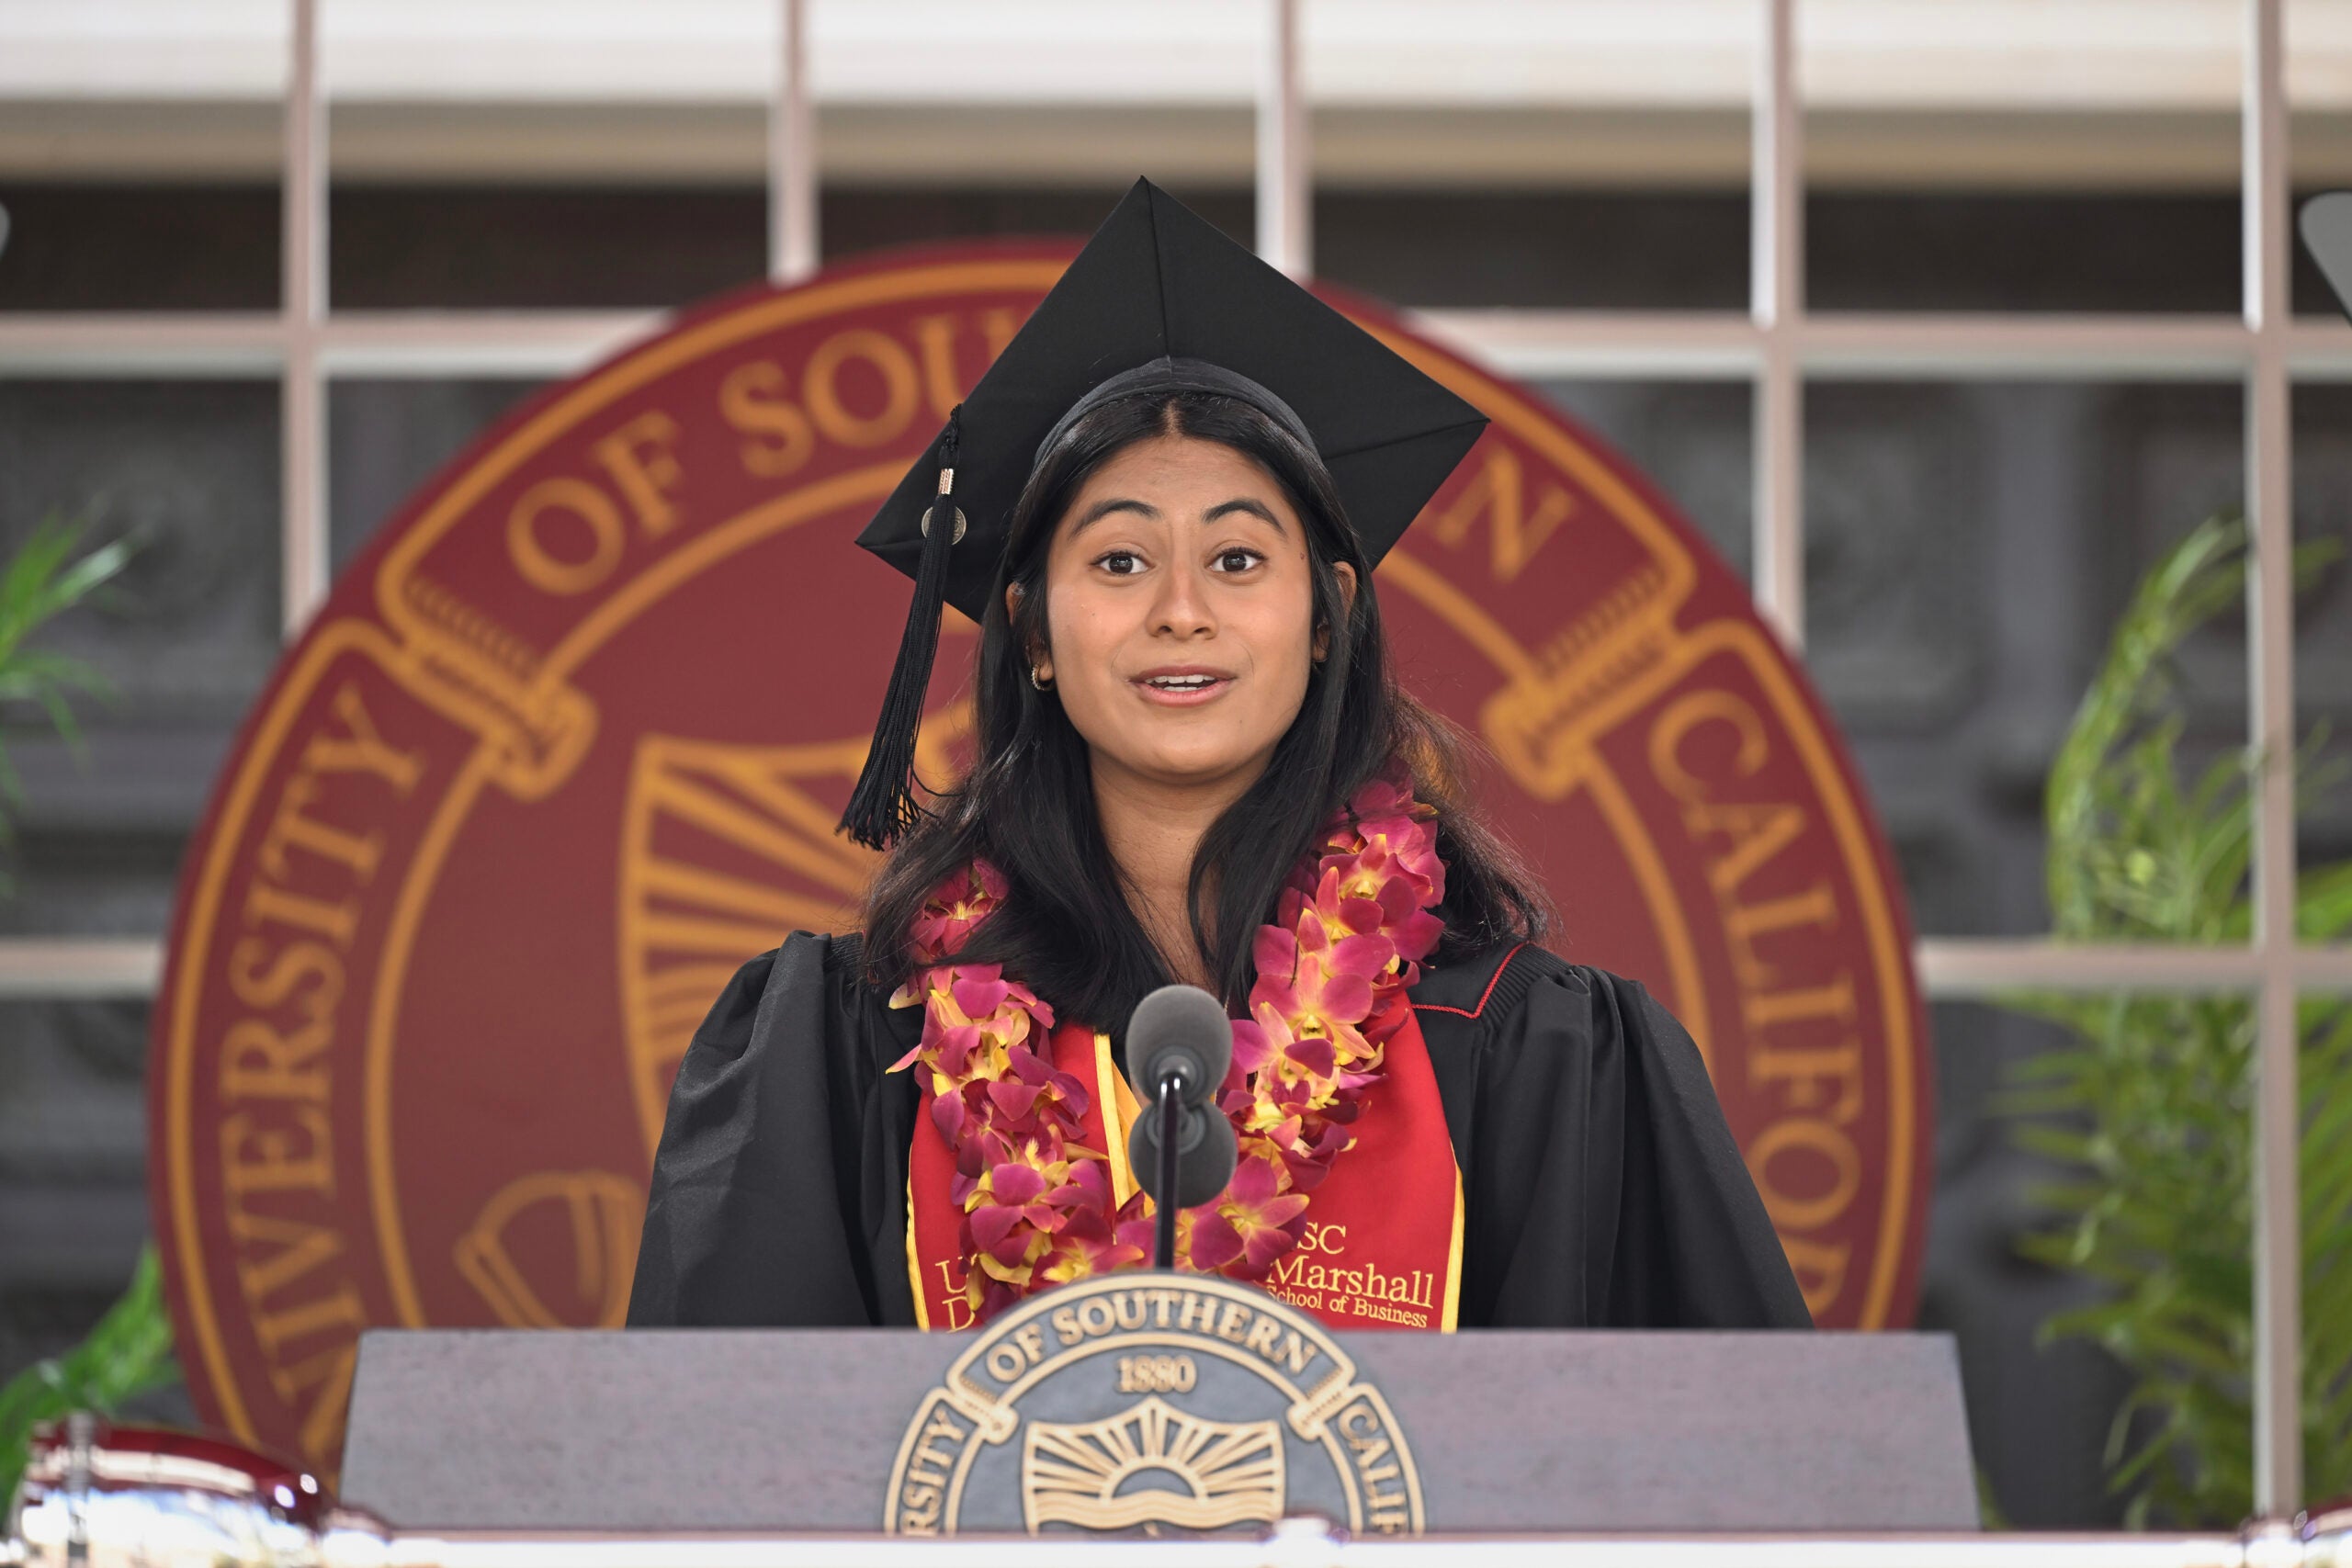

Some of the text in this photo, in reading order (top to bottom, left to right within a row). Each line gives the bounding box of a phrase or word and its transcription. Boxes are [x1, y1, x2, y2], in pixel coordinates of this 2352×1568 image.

[506, 407, 684, 596] OF
[219, 680, 426, 1497] NIVERSITY
[1266, 1255, 1433, 1309] Marshall
[1329, 1294, 1350, 1314] of
[1352, 1297, 1428, 1328] Business
[987, 1323, 1044, 1382] OF
[1052, 1288, 1317, 1375] SOUTHERN
[1115, 1355, 1197, 1393] 1880
